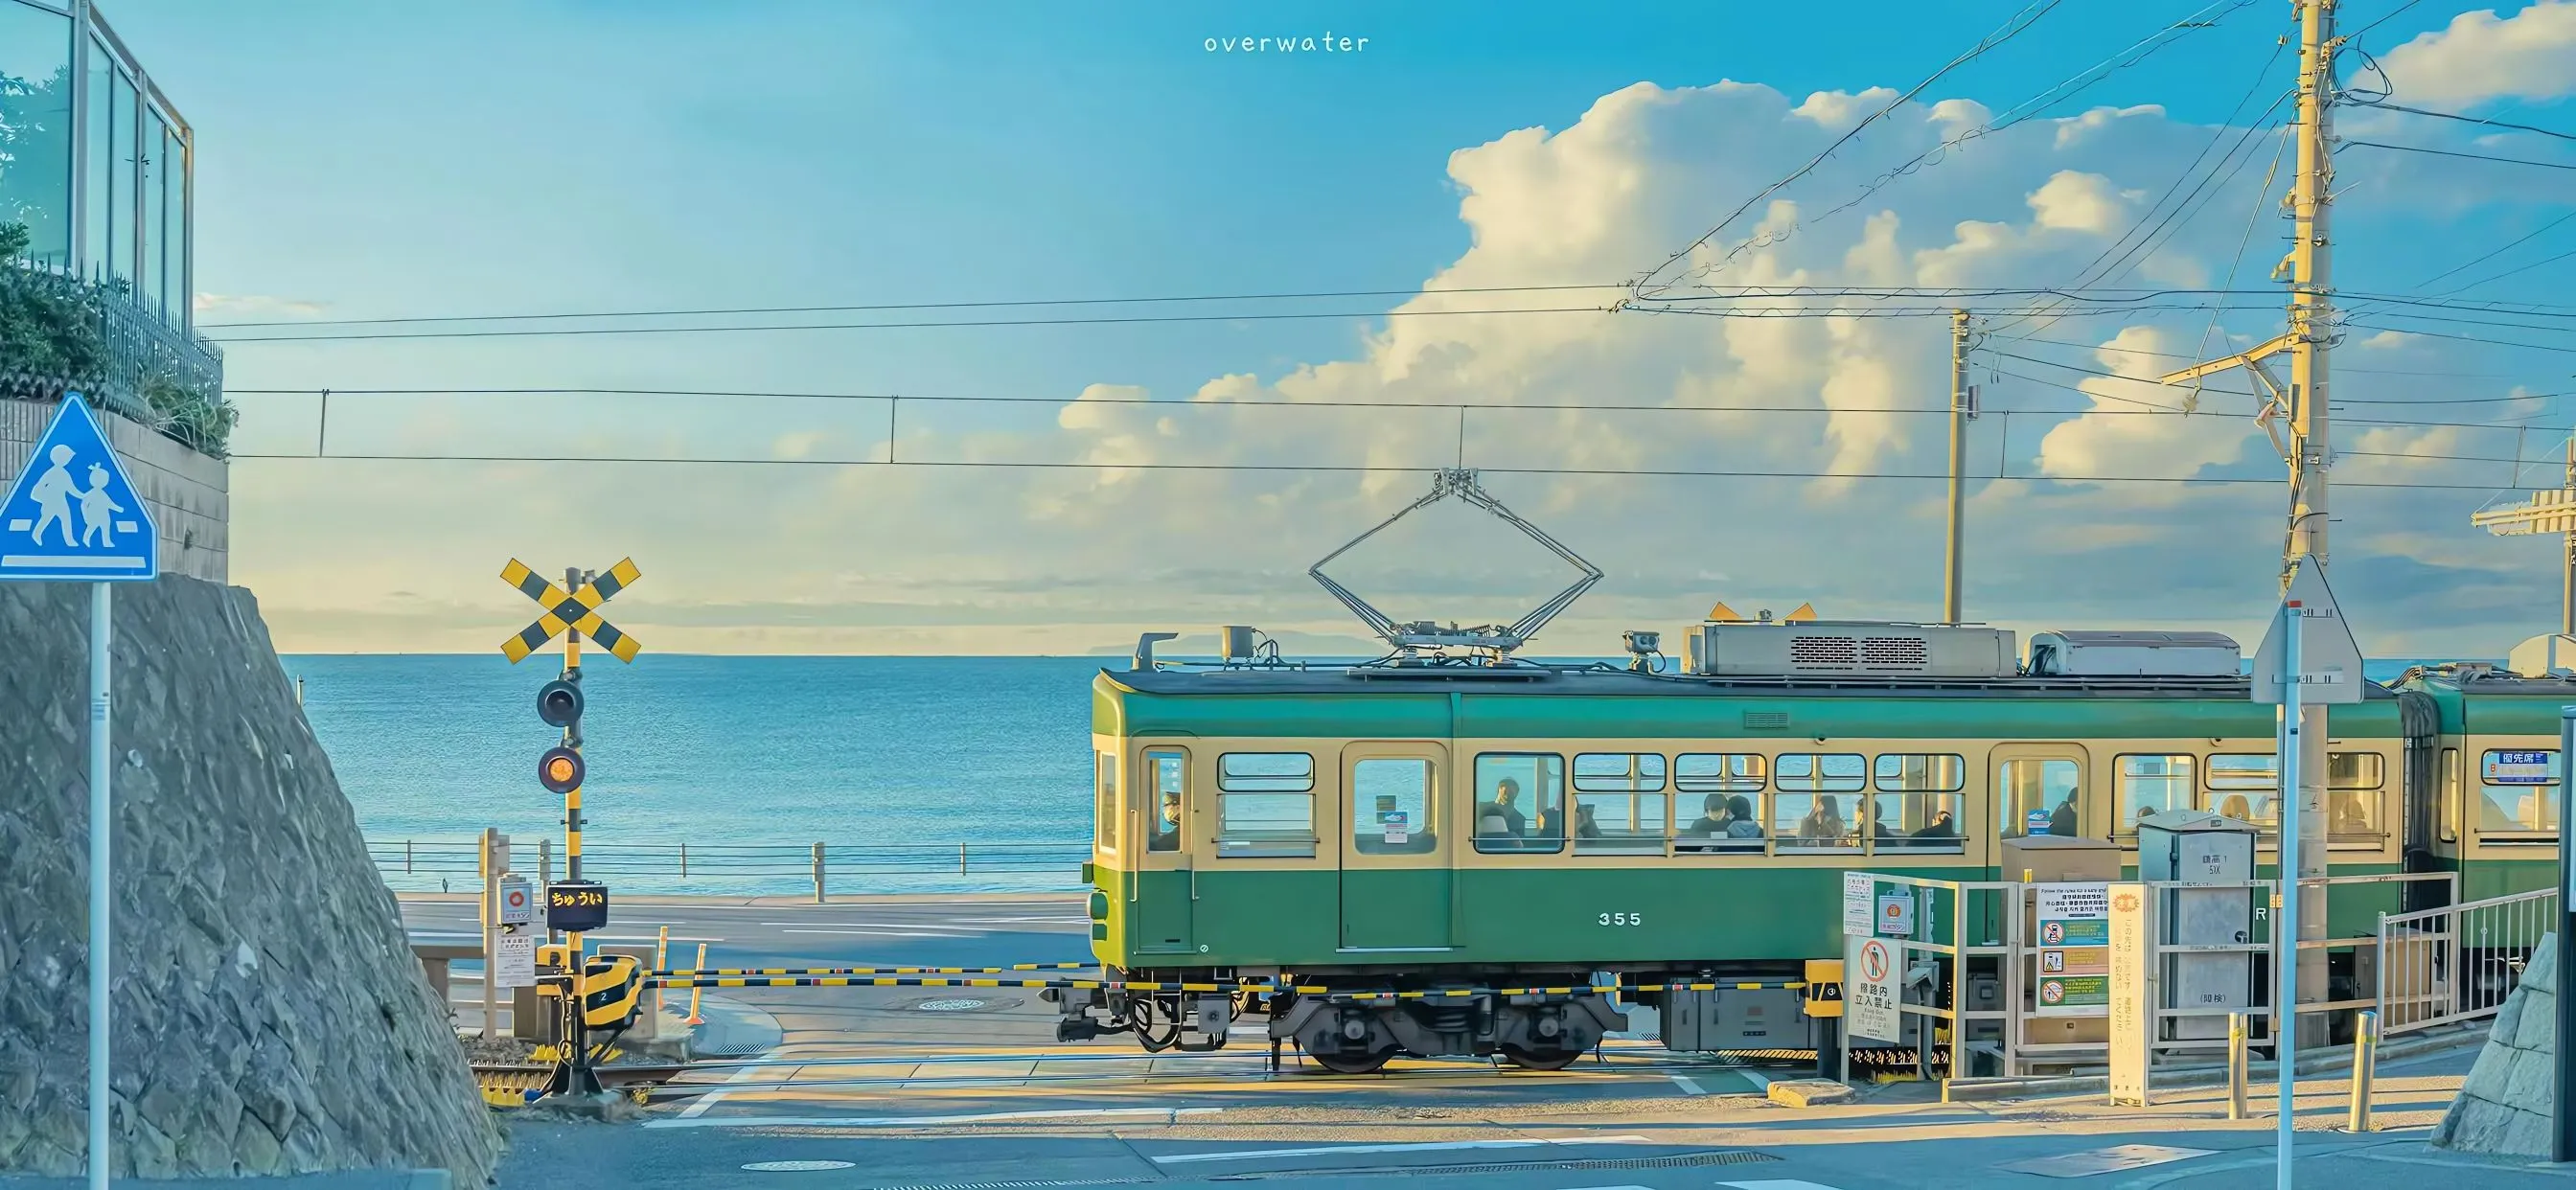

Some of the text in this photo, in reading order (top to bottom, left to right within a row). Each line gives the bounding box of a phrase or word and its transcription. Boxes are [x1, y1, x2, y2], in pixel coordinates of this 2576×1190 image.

[551, 891, 603, 906] ちゅうい
[1598, 912, 1641, 927] 355
[2255, 907, 2266, 921] R
[600, 992, 607, 1001] 2
[1855, 995, 1893, 1010] 立入禁止
